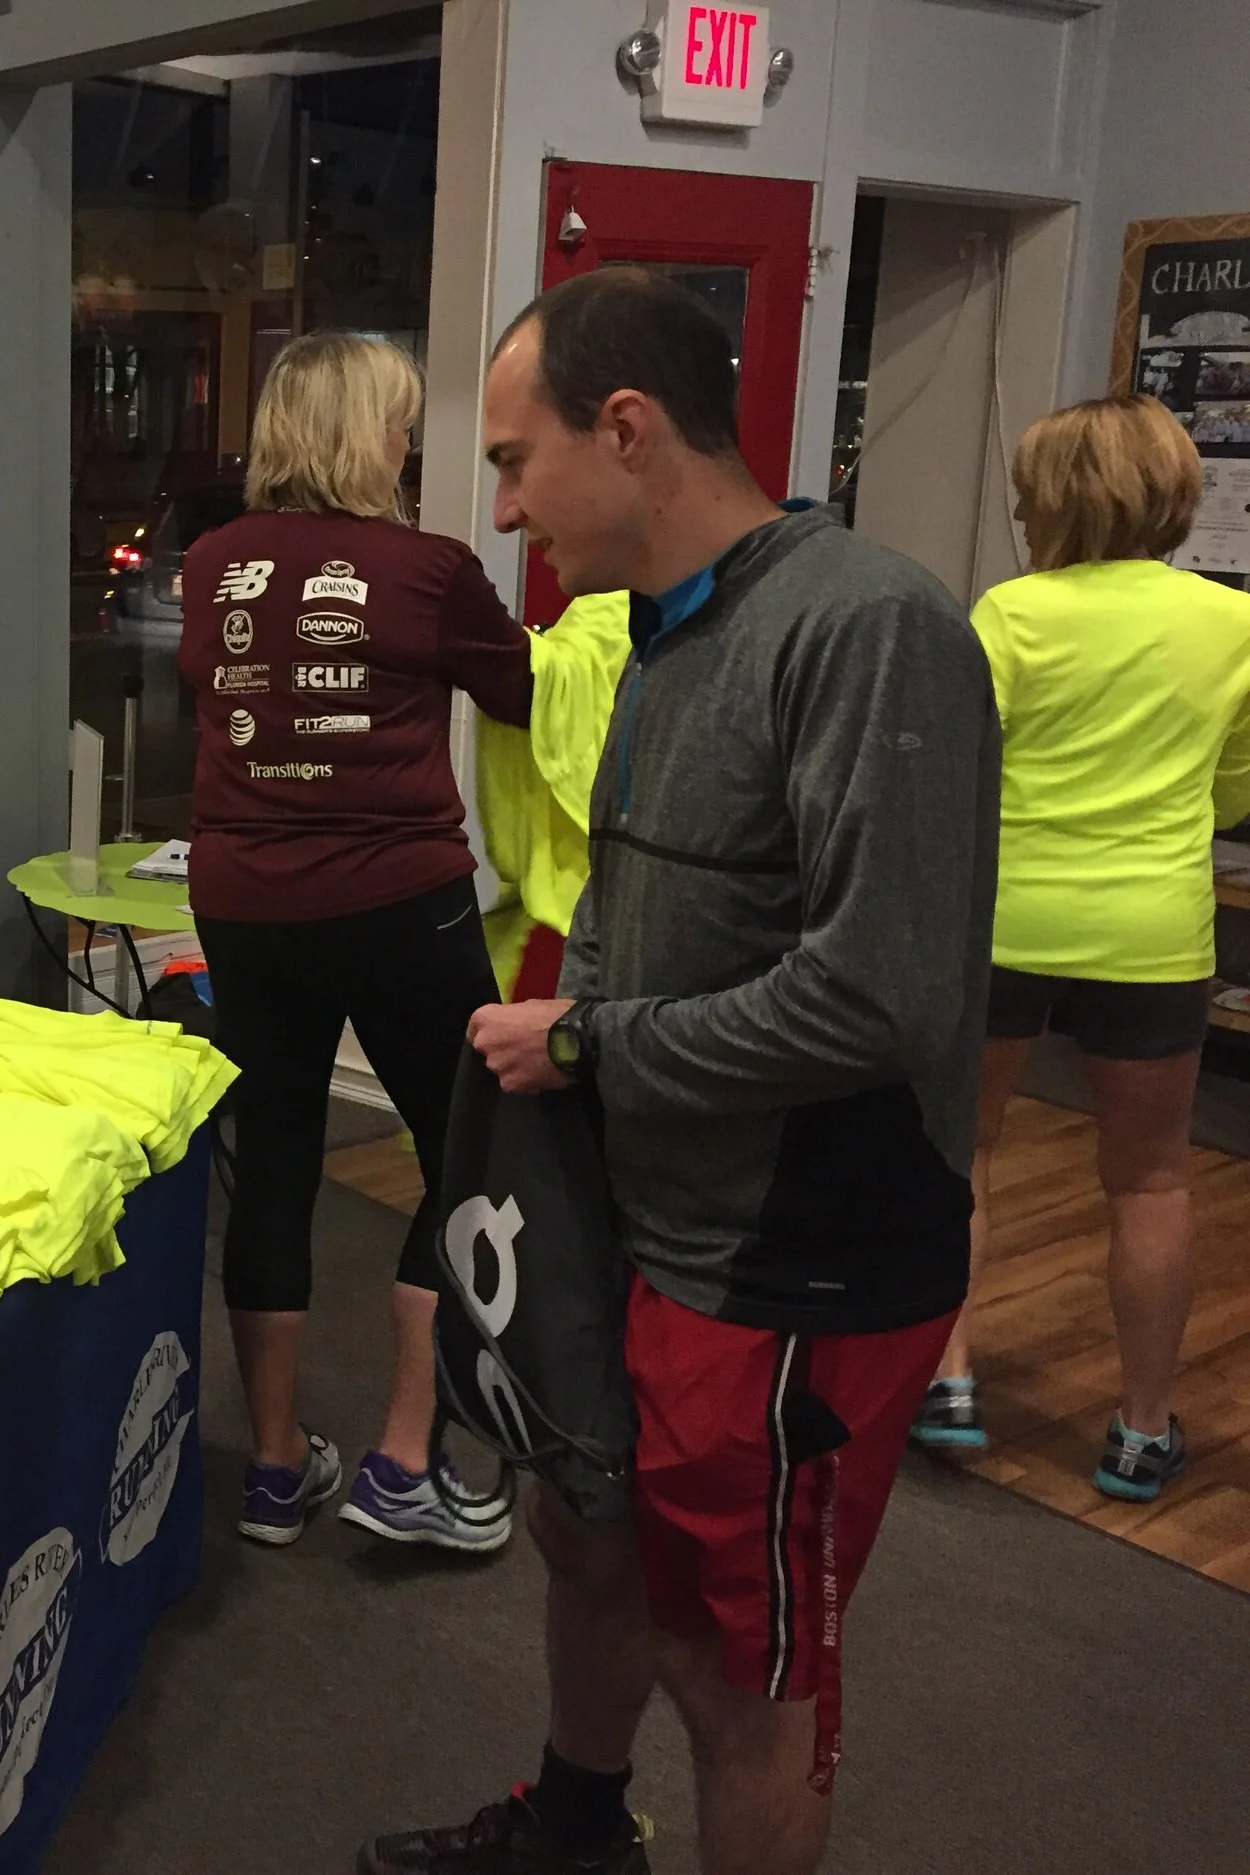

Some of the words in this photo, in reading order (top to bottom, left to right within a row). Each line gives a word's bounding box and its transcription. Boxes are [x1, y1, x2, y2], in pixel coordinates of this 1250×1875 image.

[684, 6, 757, 89] EXIT
[312, 580, 359, 596] CRAISINS
[302, 619, 359, 635] DANNON
[295, 667, 306, 687] BAR
[308, 666, 365, 689] CLIF
[246, 762, 333, 780] Transitions
[821, 1573, 838, 1648] BOSTON
